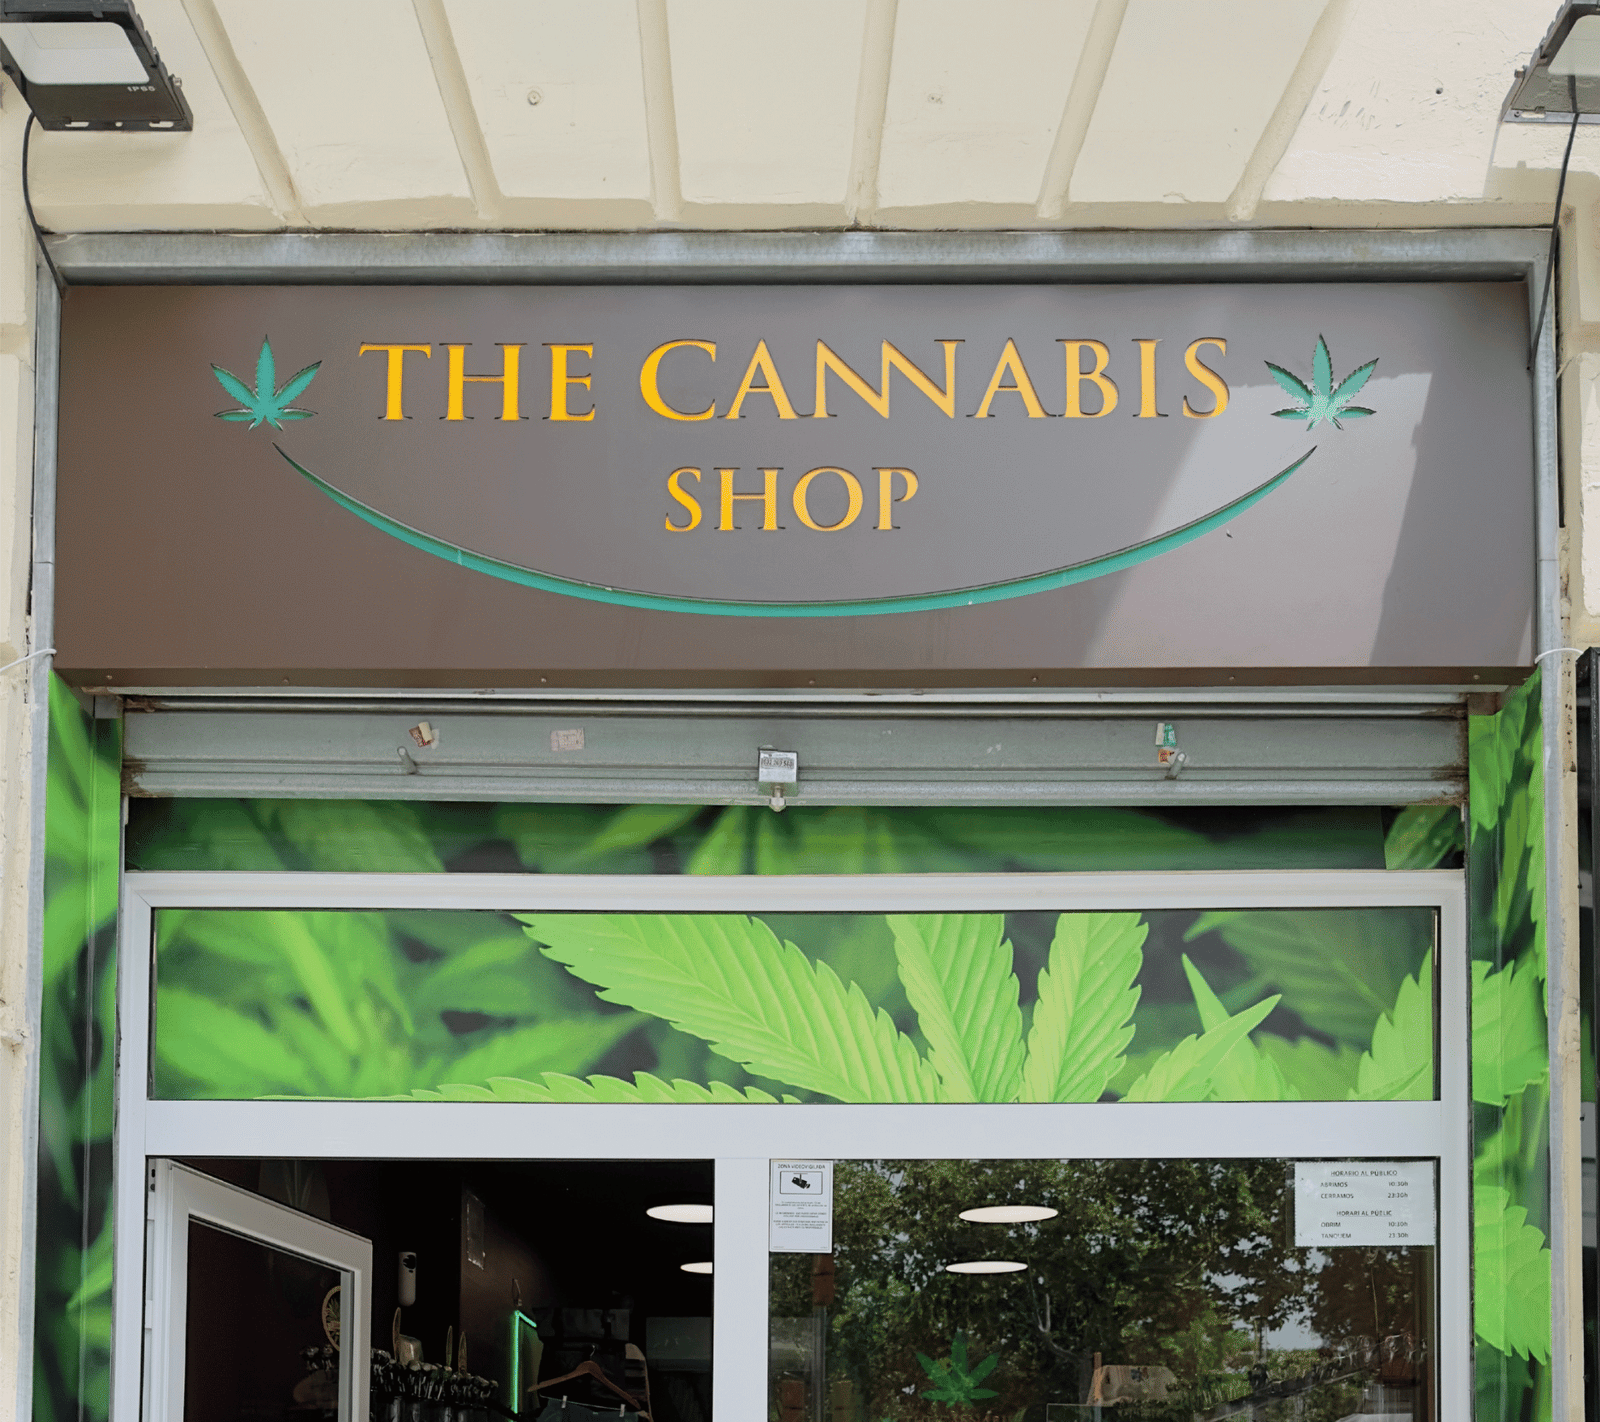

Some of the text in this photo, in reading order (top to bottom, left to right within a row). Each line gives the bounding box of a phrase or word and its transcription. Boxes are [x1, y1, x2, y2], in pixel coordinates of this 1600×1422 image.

[358, 336, 1231, 422] THE CANNABIS
[664, 465, 919, 532] SHOP
